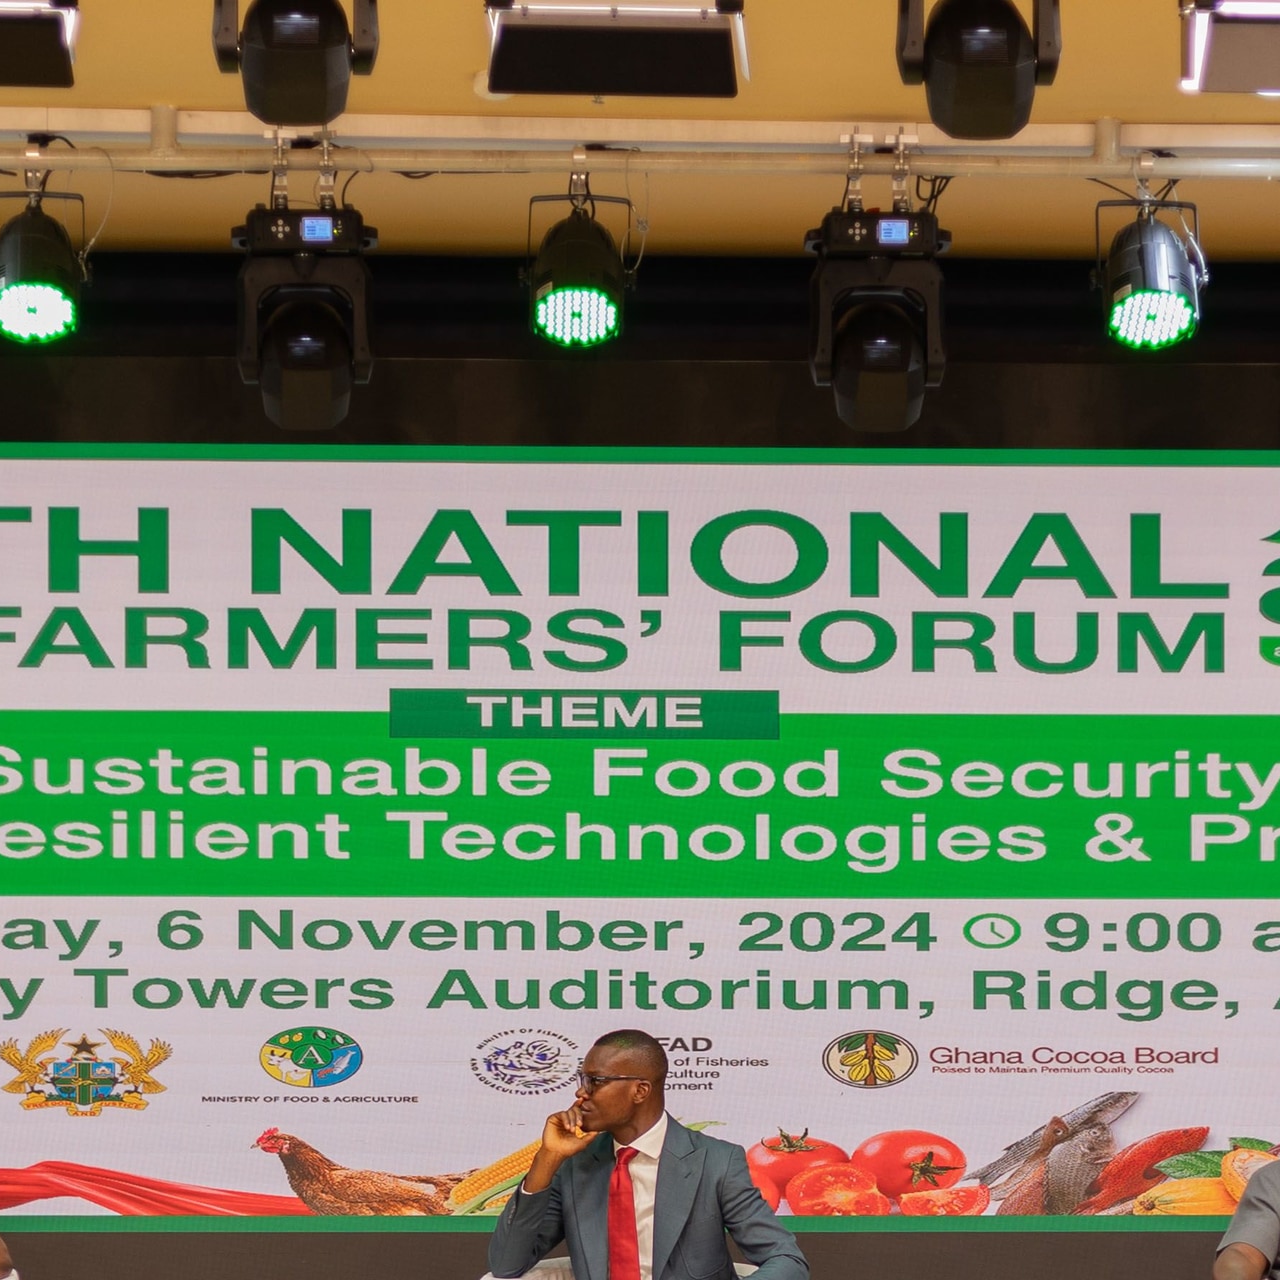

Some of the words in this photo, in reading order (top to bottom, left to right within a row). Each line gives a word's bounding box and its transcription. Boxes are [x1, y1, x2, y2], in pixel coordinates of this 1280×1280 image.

[251, 507, 1231, 599] NATIONAL
[719, 609, 1226, 674] FORUM
[466, 695, 704, 729] THEME
[593, 748, 839, 799] Food
[386, 811, 1047, 874] Technologies
[1085, 812, 1152, 864] &
[157, 909, 204, 952] 6
[238, 909, 705, 960] November,
[738, 911, 938, 953] 2024
[1043, 912, 1222, 953] 9:00
[73, 968, 395, 1011] Towers
[426, 969, 934, 1019] Auditorium,
[972, 969, 1239, 1022] Ridge,
[655, 1037, 713, 1052] FAD
[673, 1056, 690, 1067] of
[696, 1056, 769, 1067] Fisheries
[929, 1046, 1024, 1065] Ghana
[1031, 1046, 1127, 1065] Cocoa
[1135, 1047, 1219, 1065] Board
[666, 1069, 720, 1079] culture
[932, 1065, 972, 1074] Poised
[974, 1066, 986, 1074] to
[989, 1066, 1038, 1074] Maintain
[1041, 1066, 1091, 1074] Premium
[1094, 1066, 1133, 1076] Quality
[1137, 1066, 1175, 1074] Cocoa
[201, 1095, 260, 1103] MINISTRY
[262, 1095, 280, 1103] OF
[283, 1095, 320, 1103] FOOD
